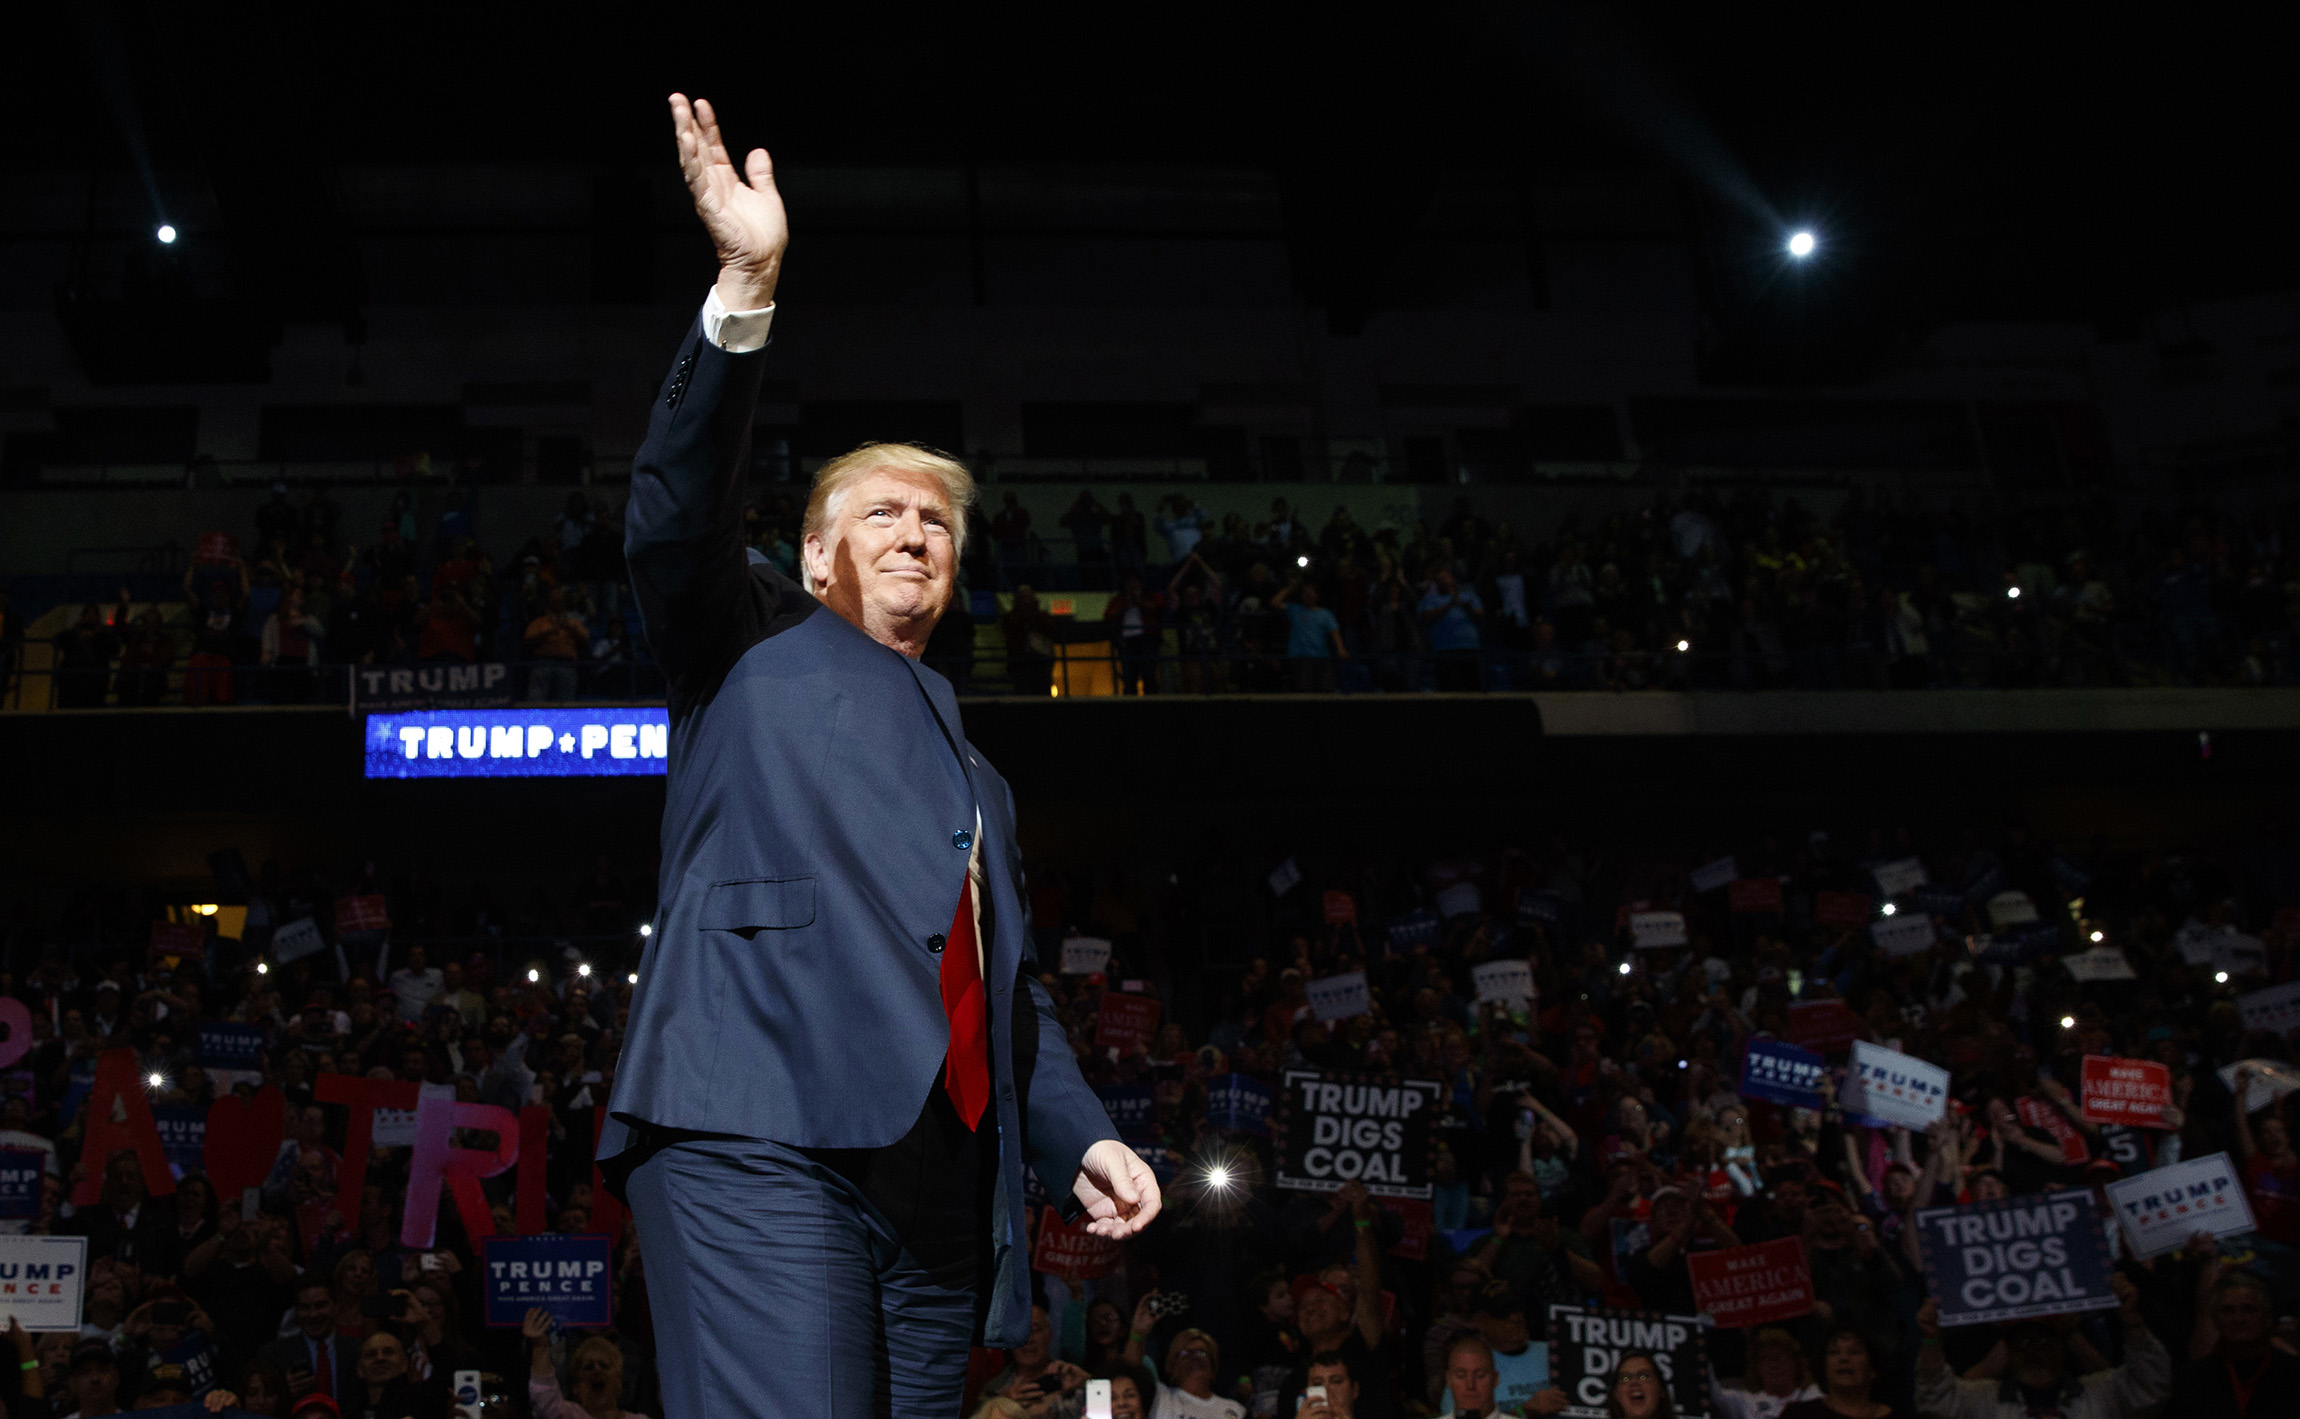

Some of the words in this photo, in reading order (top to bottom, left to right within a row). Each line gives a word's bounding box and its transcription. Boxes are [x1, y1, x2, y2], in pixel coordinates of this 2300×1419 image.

[360, 663, 507, 695] TRUMP
[400, 725, 553, 759] TRUMP
[200, 1032, 262, 1046] TRUMP
[1748, 1052, 1823, 1078] TRUMP
[1858, 1062, 1941, 1096] TRUMP
[1208, 1088, 1270, 1107] TRUMP
[1300, 1081, 1424, 1119] TRUMP
[1313, 1115, 1405, 1151] DIGS
[1303, 1146, 1408, 1183] COAL
[2125, 1177, 2229, 1216] TRUMP
[1935, 1202, 2078, 1246] TRUMP
[0, 1263, 75, 1280] UMP
[490, 1260, 604, 1279] TRUMP
[1726, 1254, 1767, 1271] MAKE
[1961, 1236, 2068, 1277] DIGS
[499, 1280, 593, 1293] PENCE
[1696, 1264, 1809, 1300] AMERICA
[1960, 1267, 2087, 1309] COAL
[1706, 1296, 1753, 1315] GREAT
[1565, 1314, 1688, 1352] TRUMP
